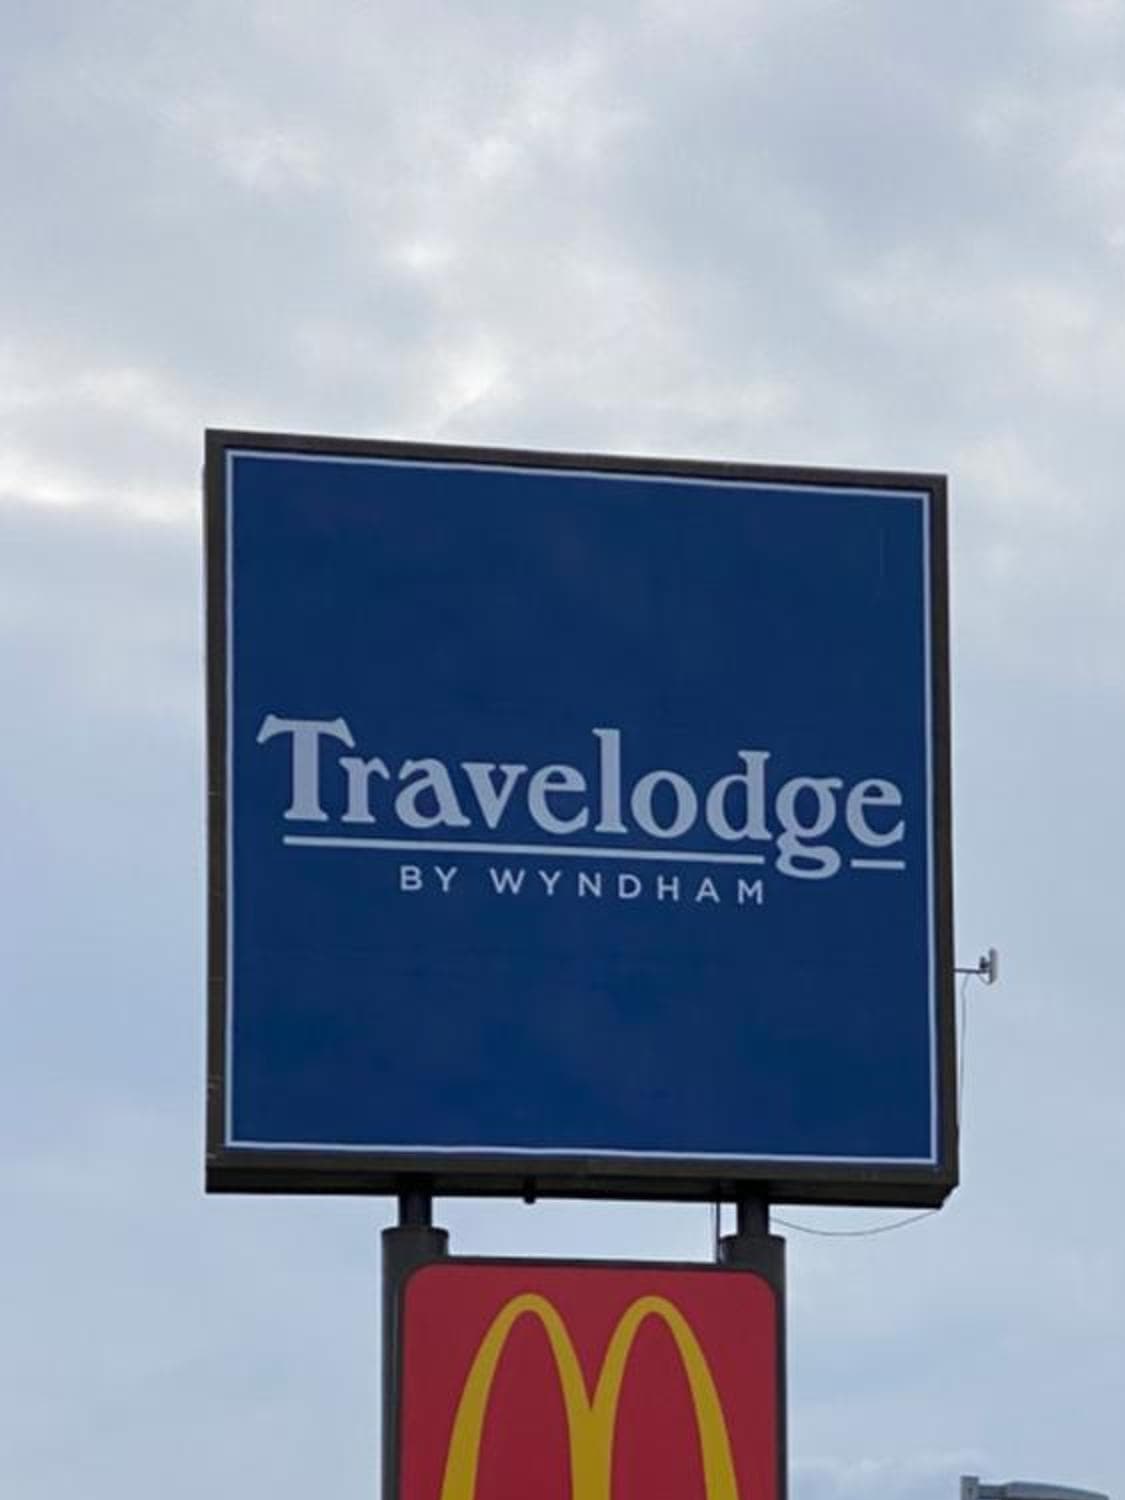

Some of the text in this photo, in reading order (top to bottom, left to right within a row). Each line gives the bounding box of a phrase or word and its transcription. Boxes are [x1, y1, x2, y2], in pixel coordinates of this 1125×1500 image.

[256, 714, 905, 880] Travelodge
[400, 865, 765, 904] BY WYNDHAM
